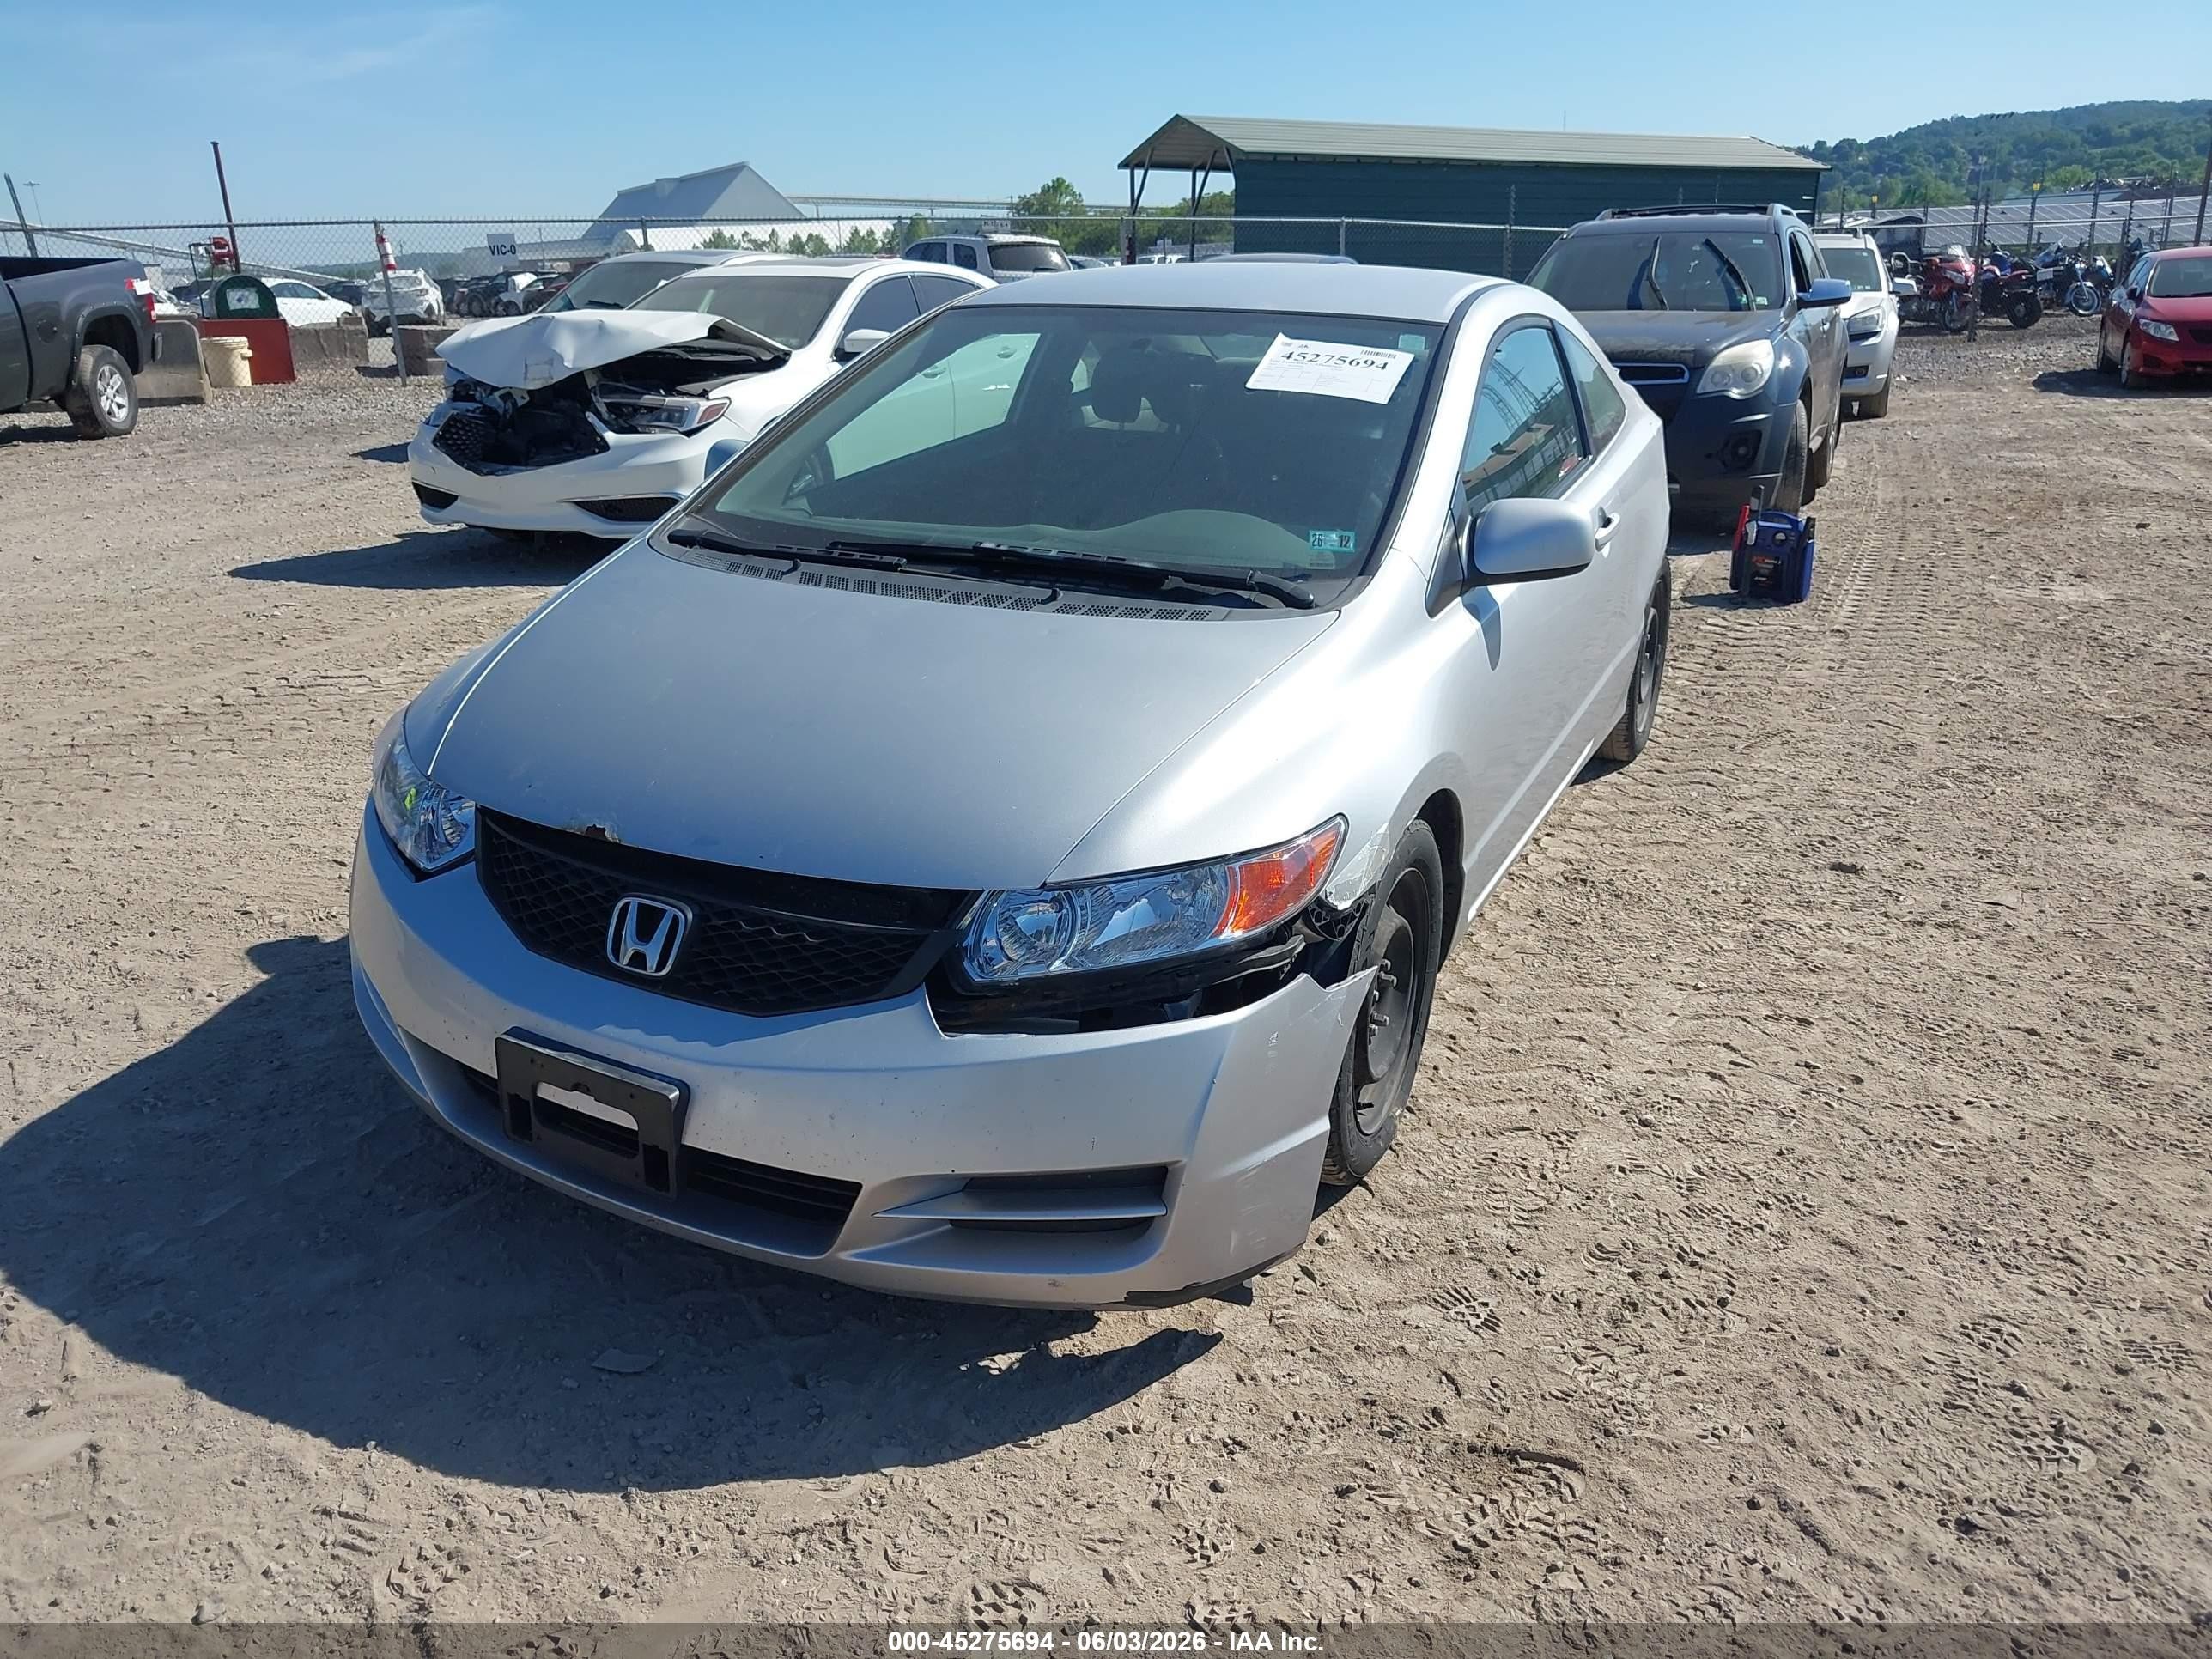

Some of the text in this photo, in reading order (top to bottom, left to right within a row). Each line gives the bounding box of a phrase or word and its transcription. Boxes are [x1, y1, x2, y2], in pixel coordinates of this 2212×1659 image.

[1280, 350, 1389, 371] 45275694
[1311, 533, 1351, 549] 26 12
